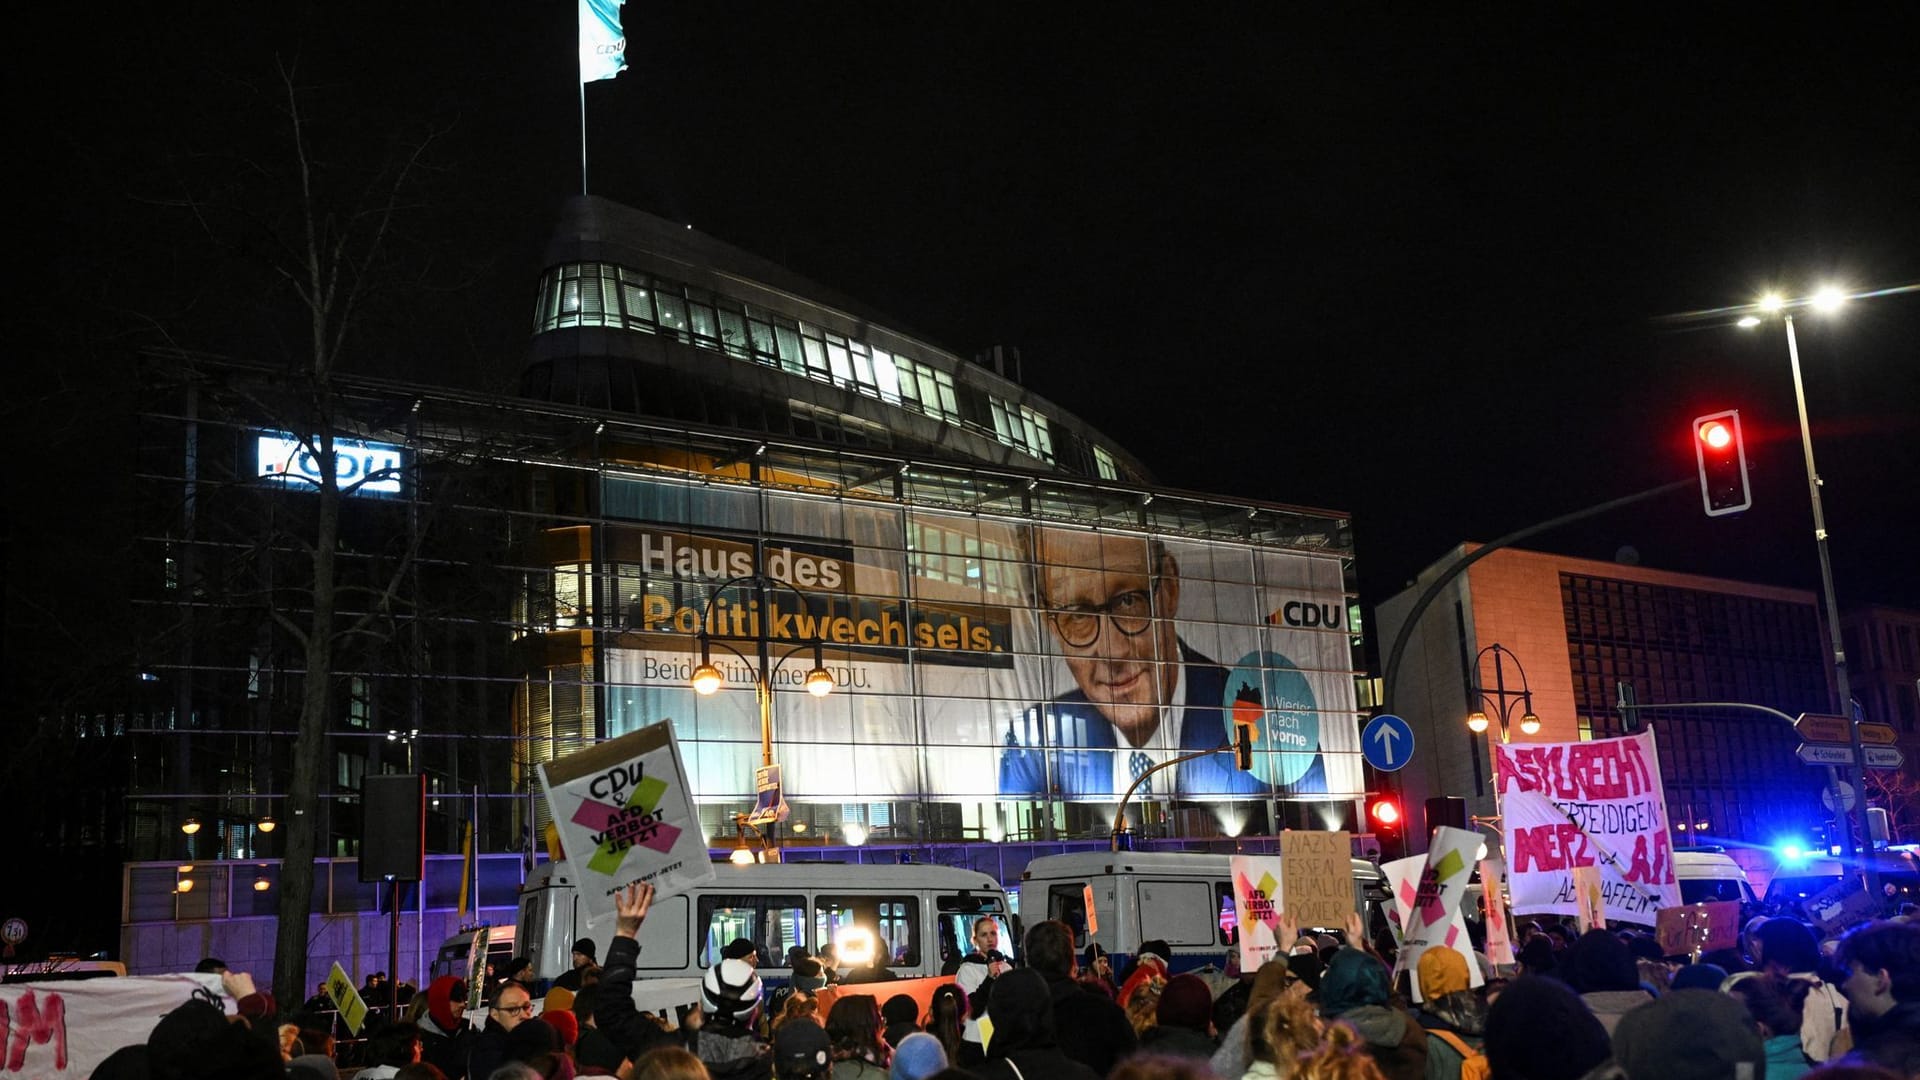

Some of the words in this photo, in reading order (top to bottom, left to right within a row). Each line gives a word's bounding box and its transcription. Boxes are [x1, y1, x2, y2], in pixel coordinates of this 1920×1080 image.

[597, 39, 625, 55] CDU
[299, 450, 393, 482] CDU
[641, 533, 754, 579] Haus
[769, 547, 842, 588] des
[1283, 601, 1341, 629] CDU
[643, 657, 695, 681] Beid
[1271, 696, 1312, 717] Wieder
[1271, 714, 1299, 729] nach
[1271, 729, 1307, 747] vorne
[589, 761, 644, 799] CDU
[1496, 738, 1652, 801] ASYLRECHT
[613, 791, 628, 806] &
[590, 808, 664, 845] VERBOT
[607, 805, 643, 827] AFD
[607, 824, 659, 855] JETZT
[1289, 833, 1338, 854] NAZIS
[1514, 823, 1595, 873] MERZ
[1288, 857, 1335, 876] ESSEN
[1243, 900, 1275, 910] VERBOT
[1248, 890, 1266, 899] AFD
[1248, 910, 1273, 920] JETZT
[1288, 898, 1344, 922] DÖNER
[0, 985, 67, 1072] M
